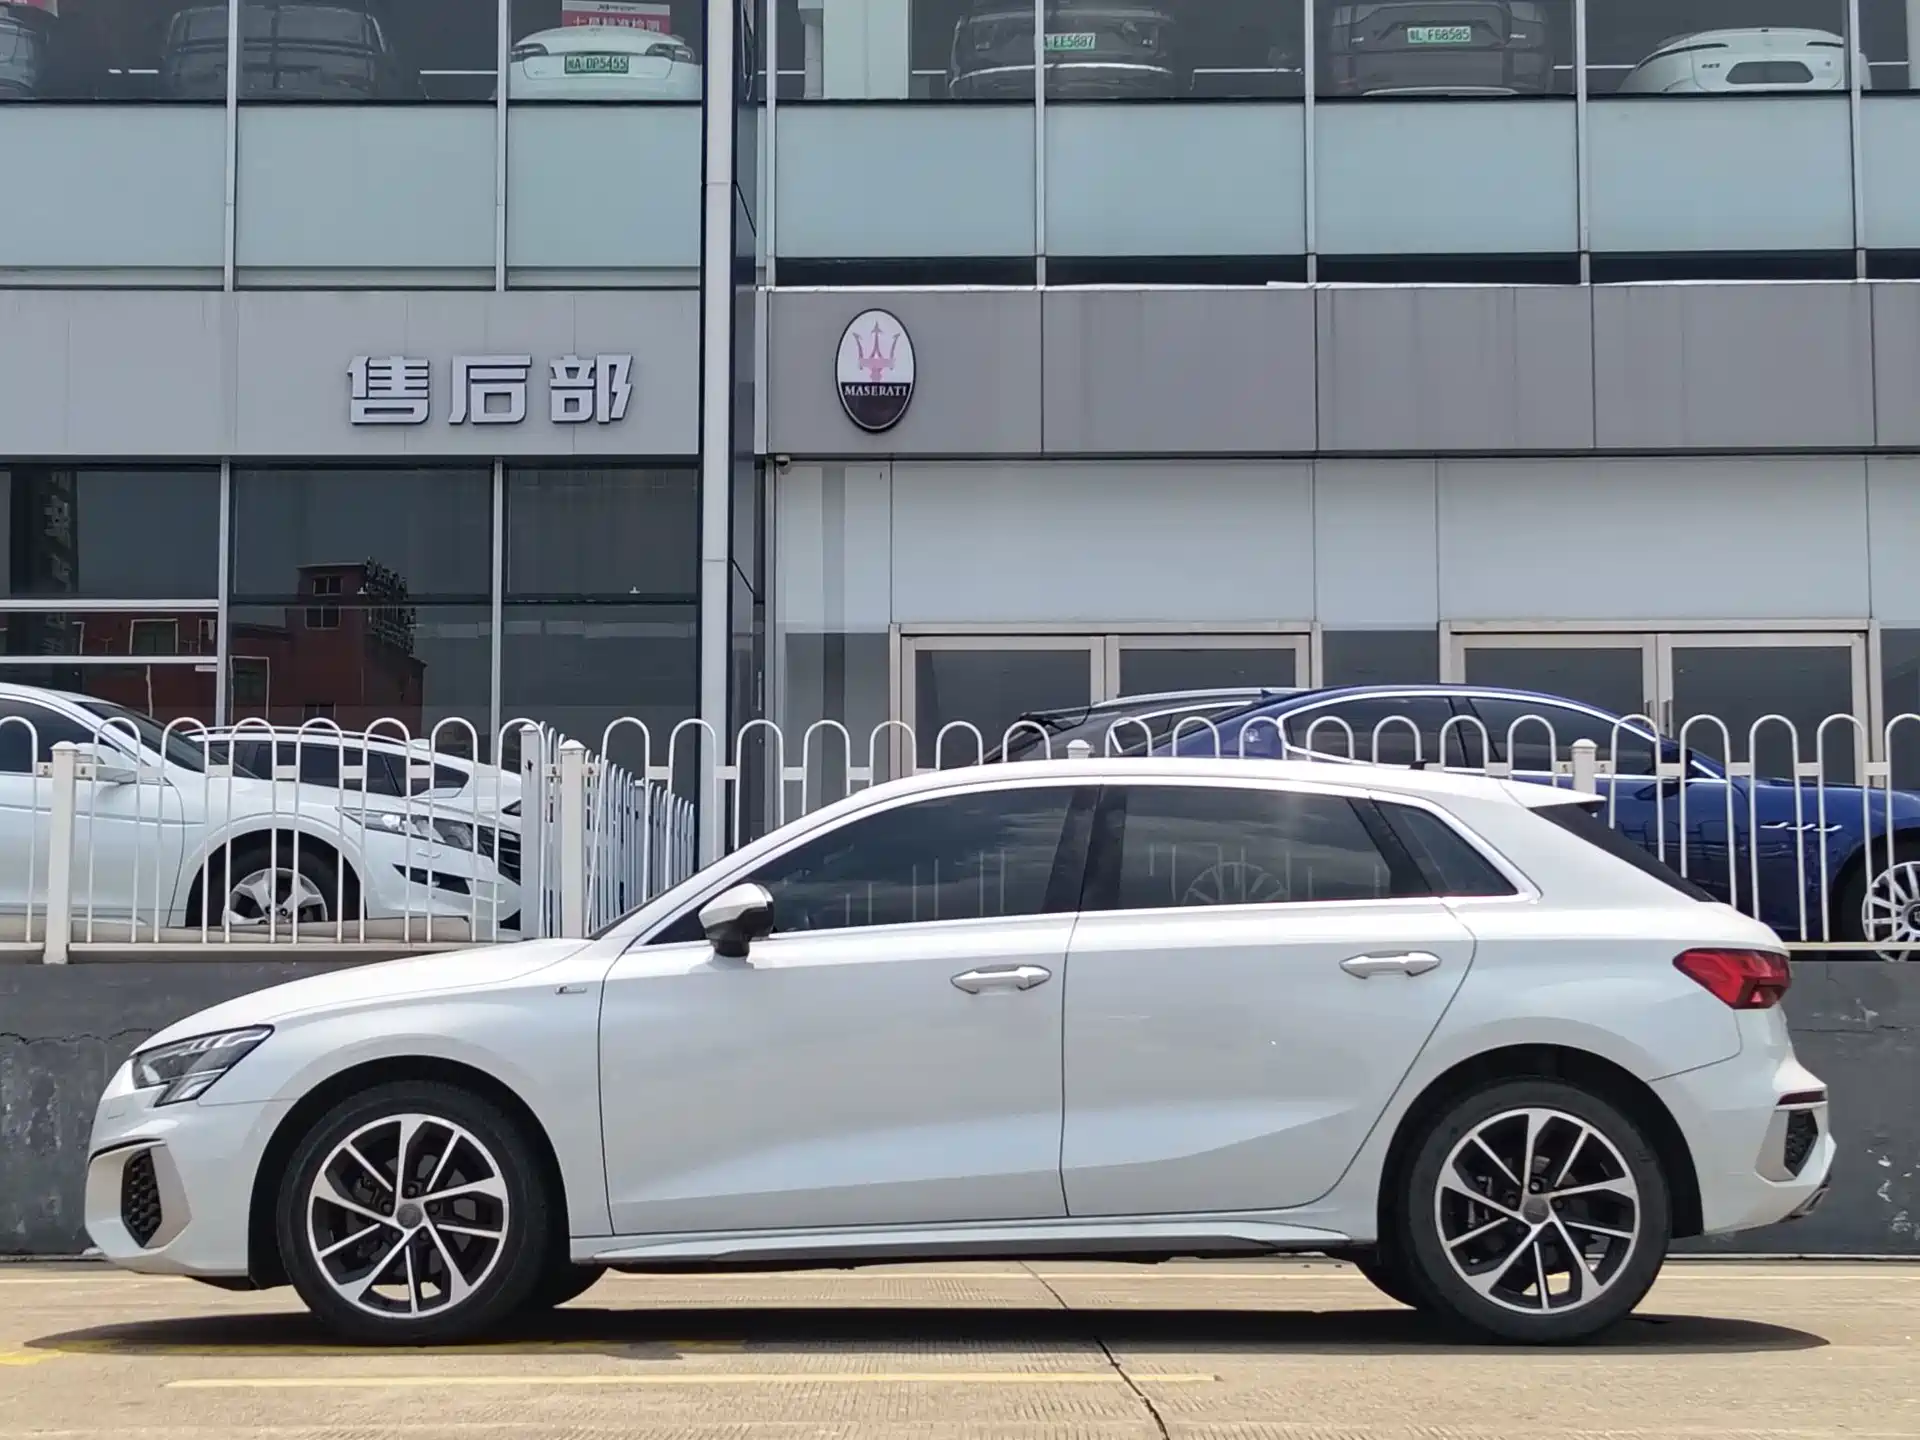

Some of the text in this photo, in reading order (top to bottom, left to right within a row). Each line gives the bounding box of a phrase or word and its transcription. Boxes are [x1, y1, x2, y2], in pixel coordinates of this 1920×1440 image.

[347, 352, 633, 424] 售后部
[844, 385, 908, 397] MASERATI
